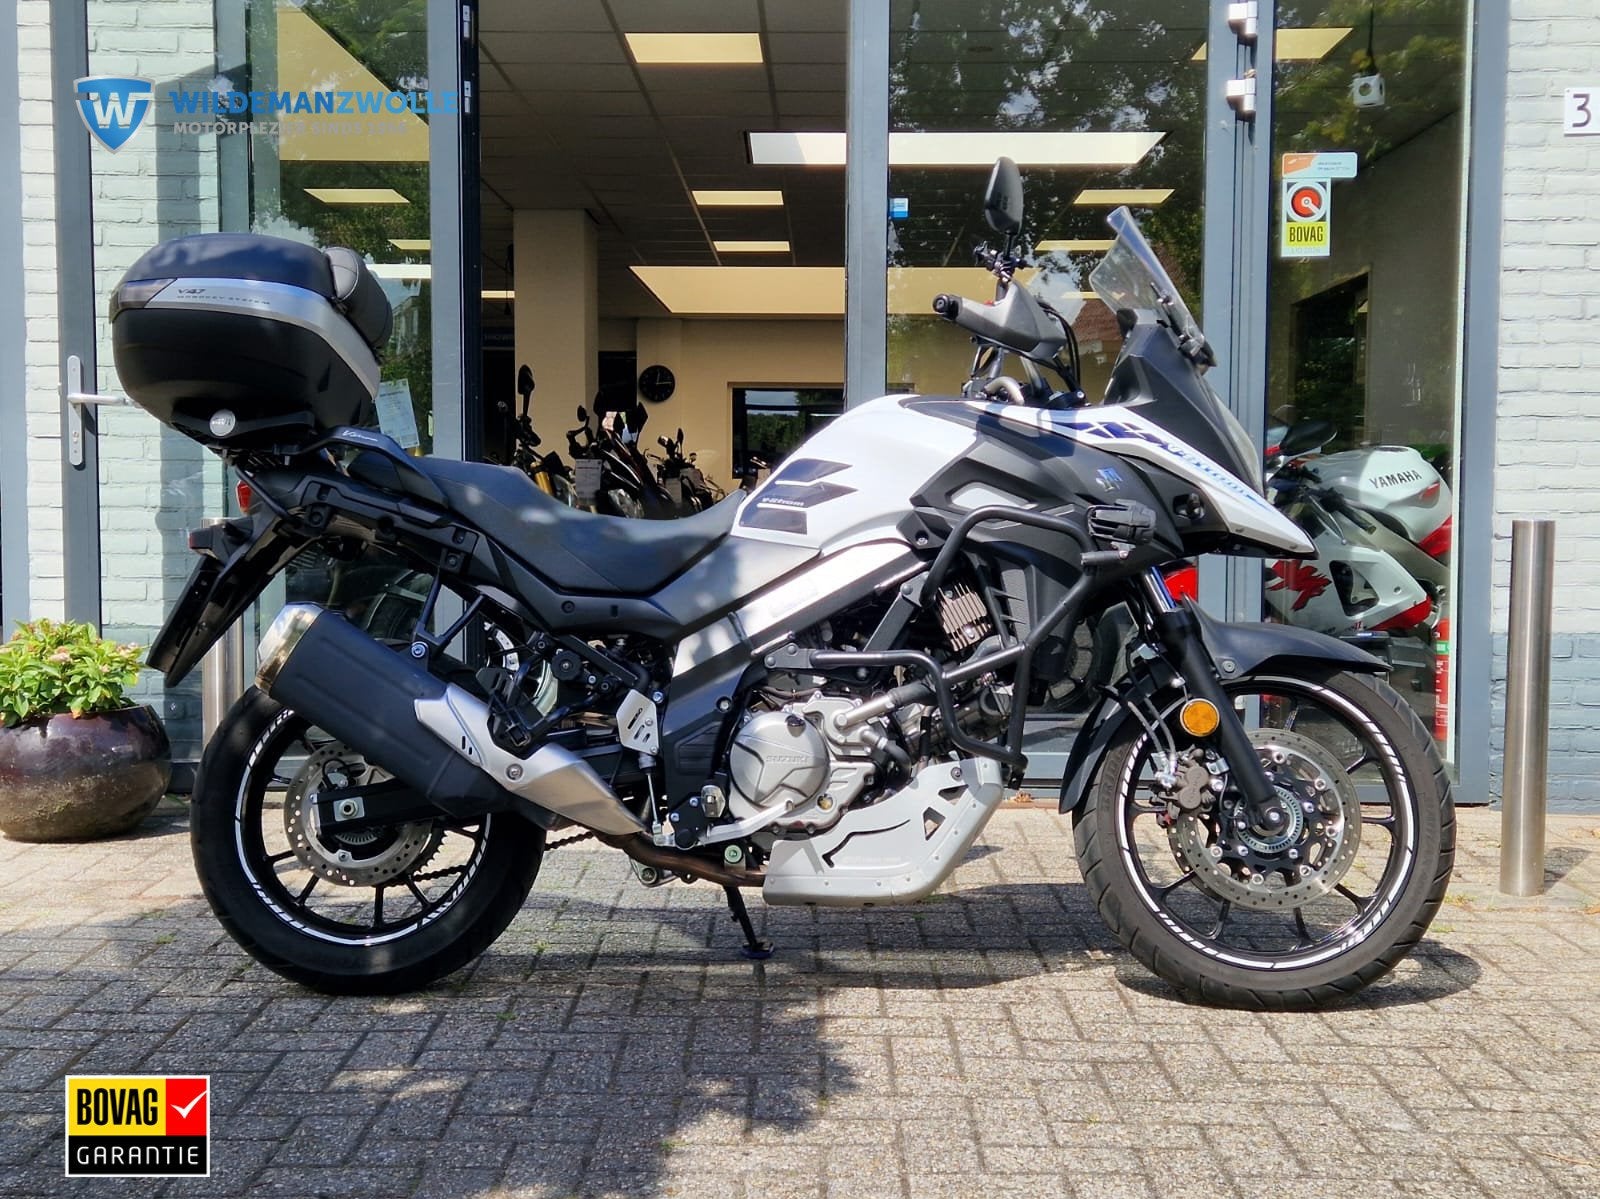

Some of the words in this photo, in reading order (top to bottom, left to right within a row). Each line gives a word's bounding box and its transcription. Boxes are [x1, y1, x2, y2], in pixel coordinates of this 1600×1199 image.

[1572, 93, 1592, 128] 3
[1289, 225, 1324, 243] BOVAG
[1368, 469, 1423, 489] YAMAHA
